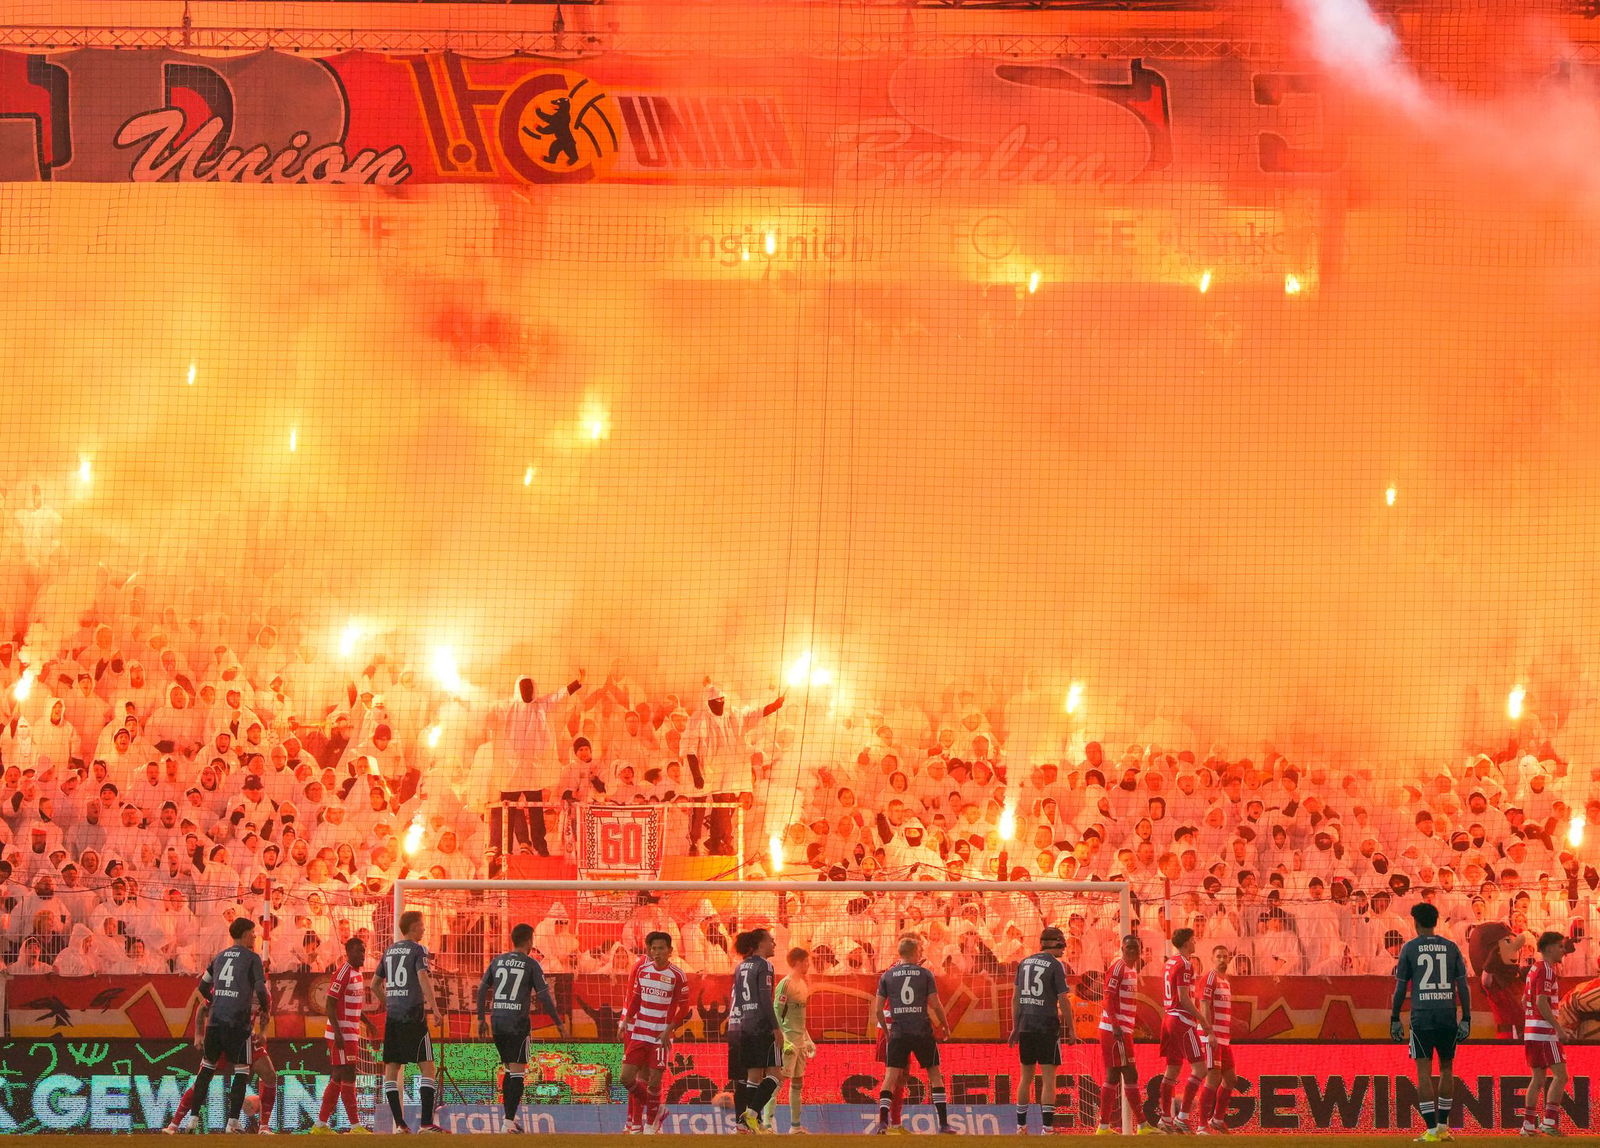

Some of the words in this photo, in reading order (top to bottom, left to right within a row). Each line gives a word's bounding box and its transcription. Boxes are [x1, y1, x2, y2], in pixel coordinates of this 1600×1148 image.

[114, 107, 412, 183] Union
[617, 96, 801, 169] UNION
[827, 116, 1110, 190] Berlin
[601, 822, 643, 866] 60
[505, 959, 526, 968] GÖTZE
[1418, 944, 1447, 952] BROWN
[218, 958, 235, 988] 4
[385, 955, 408, 988] 16
[494, 967, 525, 1001] 27
[740, 969, 751, 1001] 3
[1021, 964, 1046, 997] 13
[1417, 953, 1452, 990] 21
[900, 976, 915, 1005] 6
[1419, 991, 1454, 1001] EINTRACHT
[893, 1006, 922, 1014] EINTRACHT
[655, 1047, 665, 1061] 11
